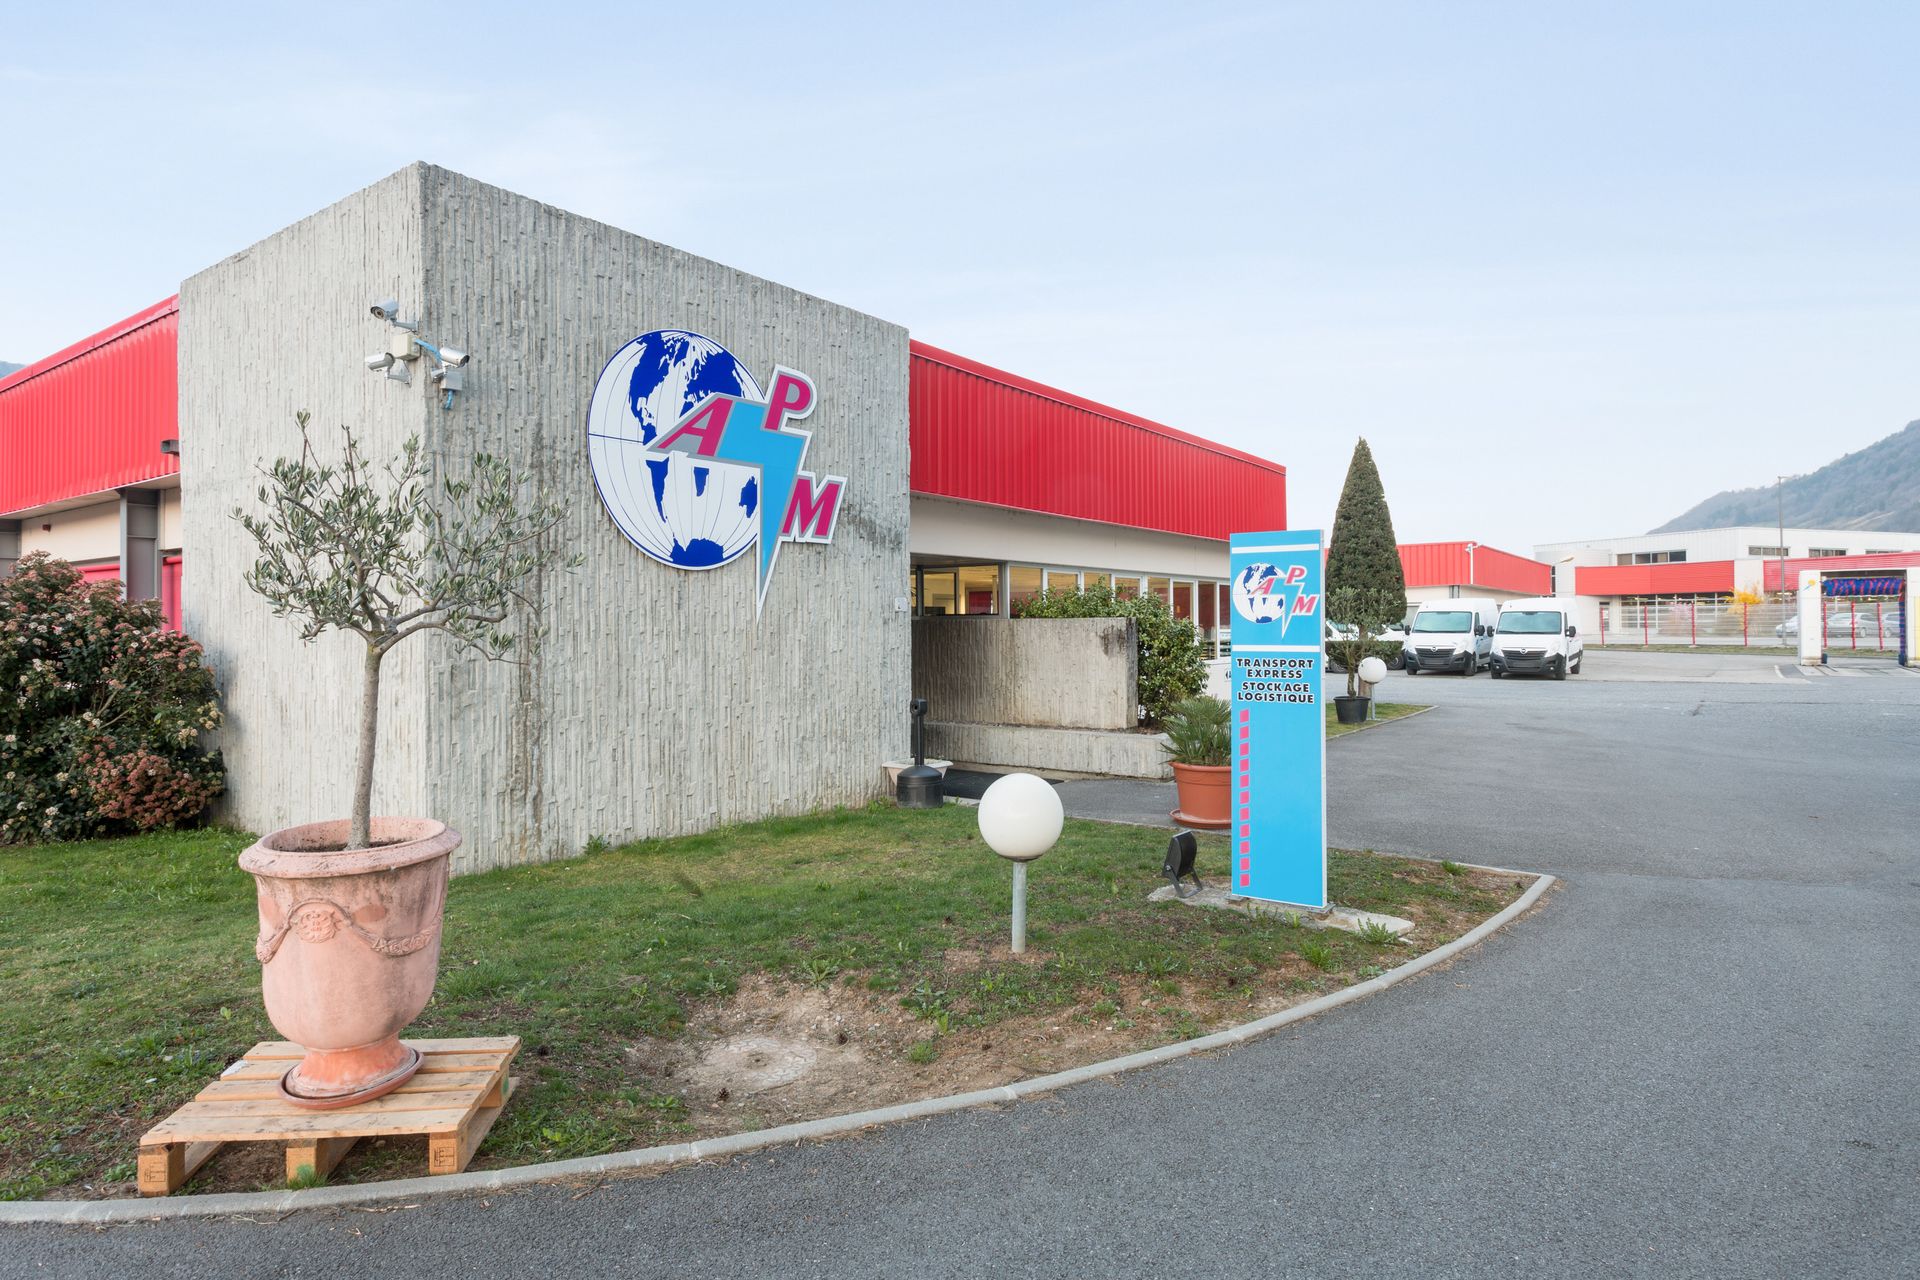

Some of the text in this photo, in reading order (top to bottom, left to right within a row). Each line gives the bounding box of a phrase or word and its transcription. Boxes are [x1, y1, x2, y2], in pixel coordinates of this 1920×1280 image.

[1236, 658, 1314, 669] TRANSPORT
[1247, 669, 1303, 679] EXPRESS
[1242, 682, 1310, 693] STOCKAGE
[1237, 692, 1314, 704] LOGISTIQUE
